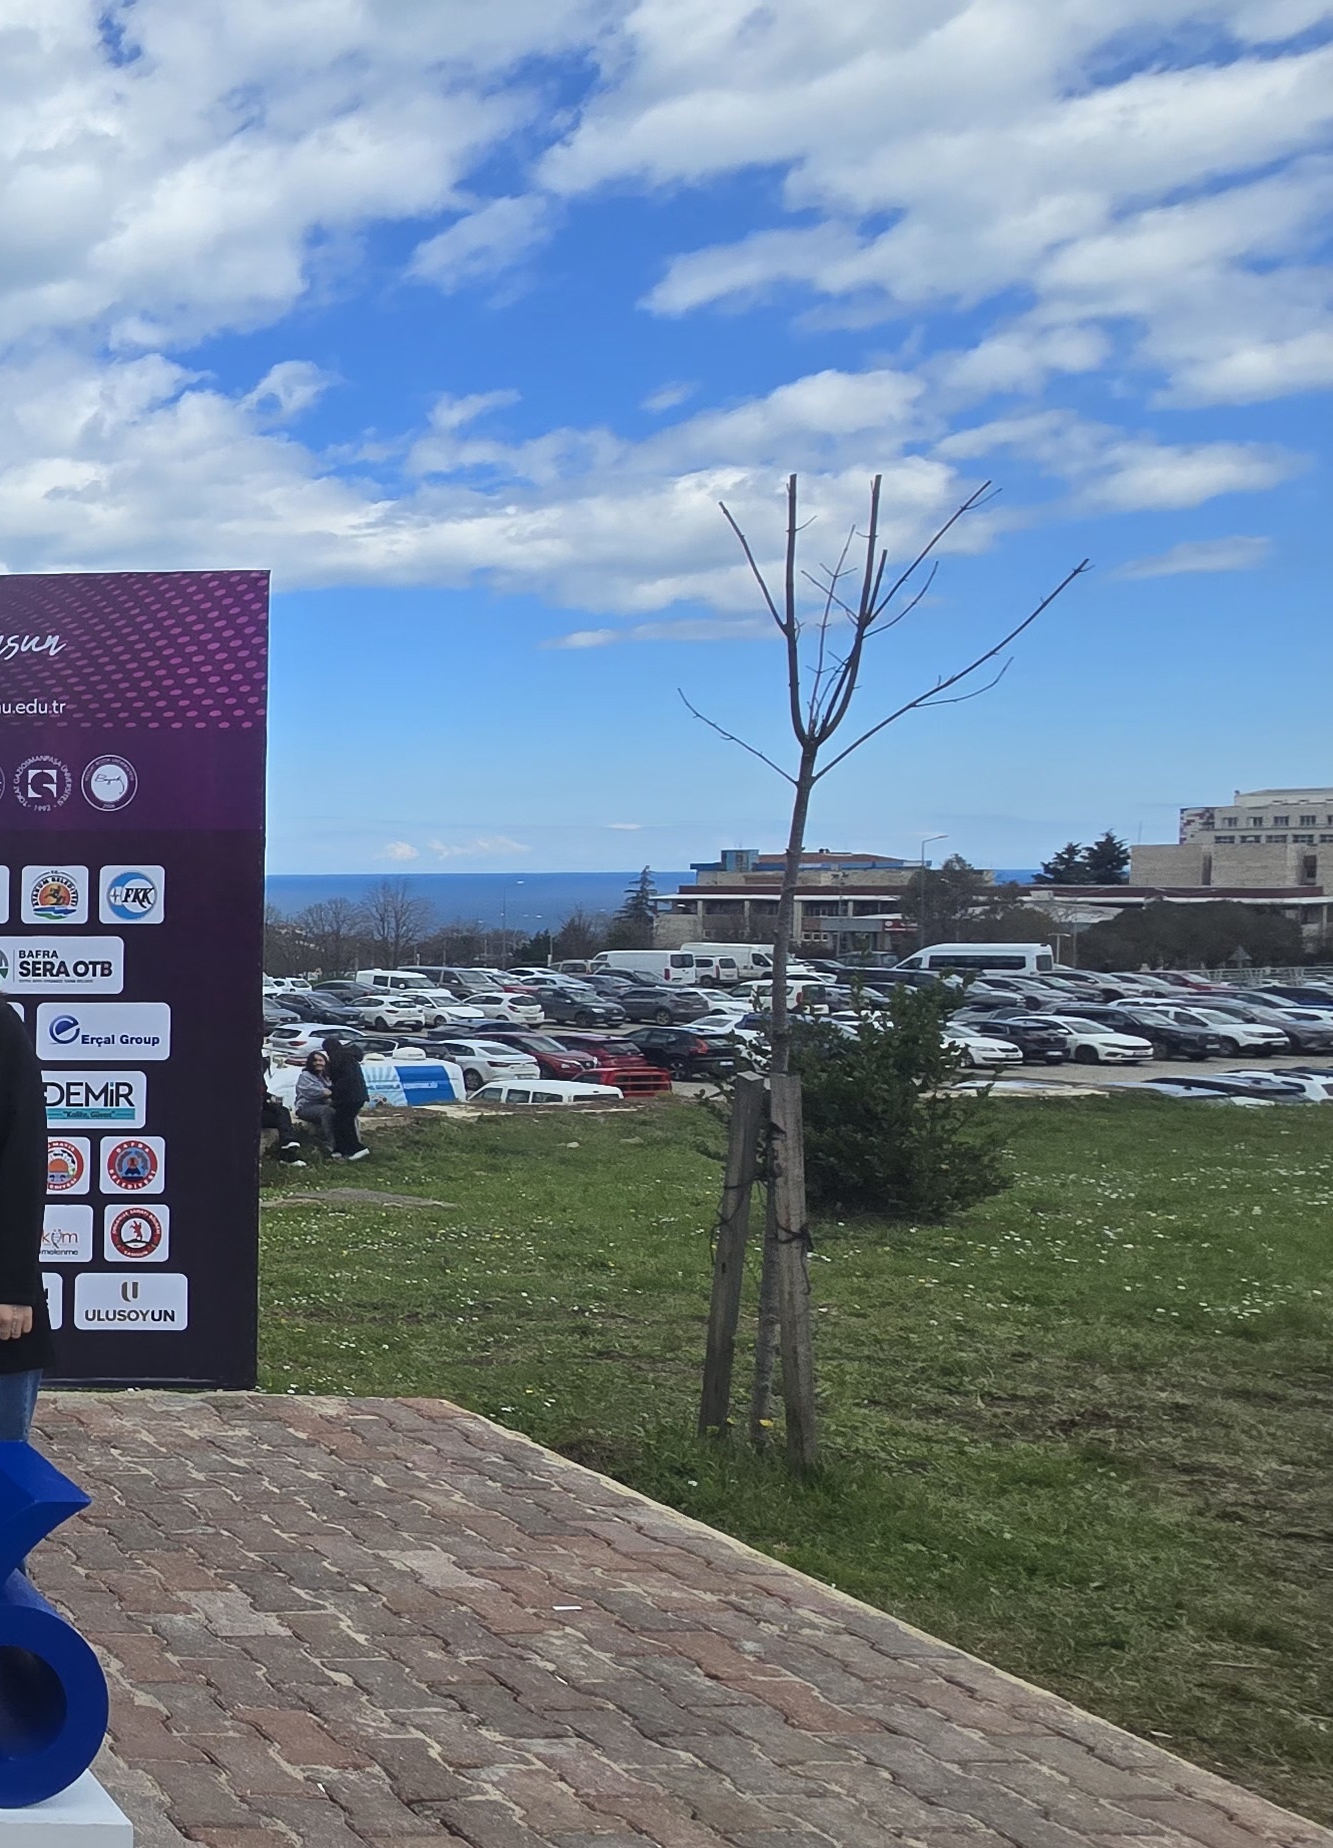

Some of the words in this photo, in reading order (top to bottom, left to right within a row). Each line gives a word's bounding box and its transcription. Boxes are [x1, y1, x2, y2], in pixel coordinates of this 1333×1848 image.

[121, 887, 154, 909] FKK
[18, 950, 59, 959] BAFRA
[18, 960, 71, 977] SERA
[72, 960, 113, 977] OTB
[81, 1034, 115, 1047] Erçal
[119, 1034, 160, 1047] Group
